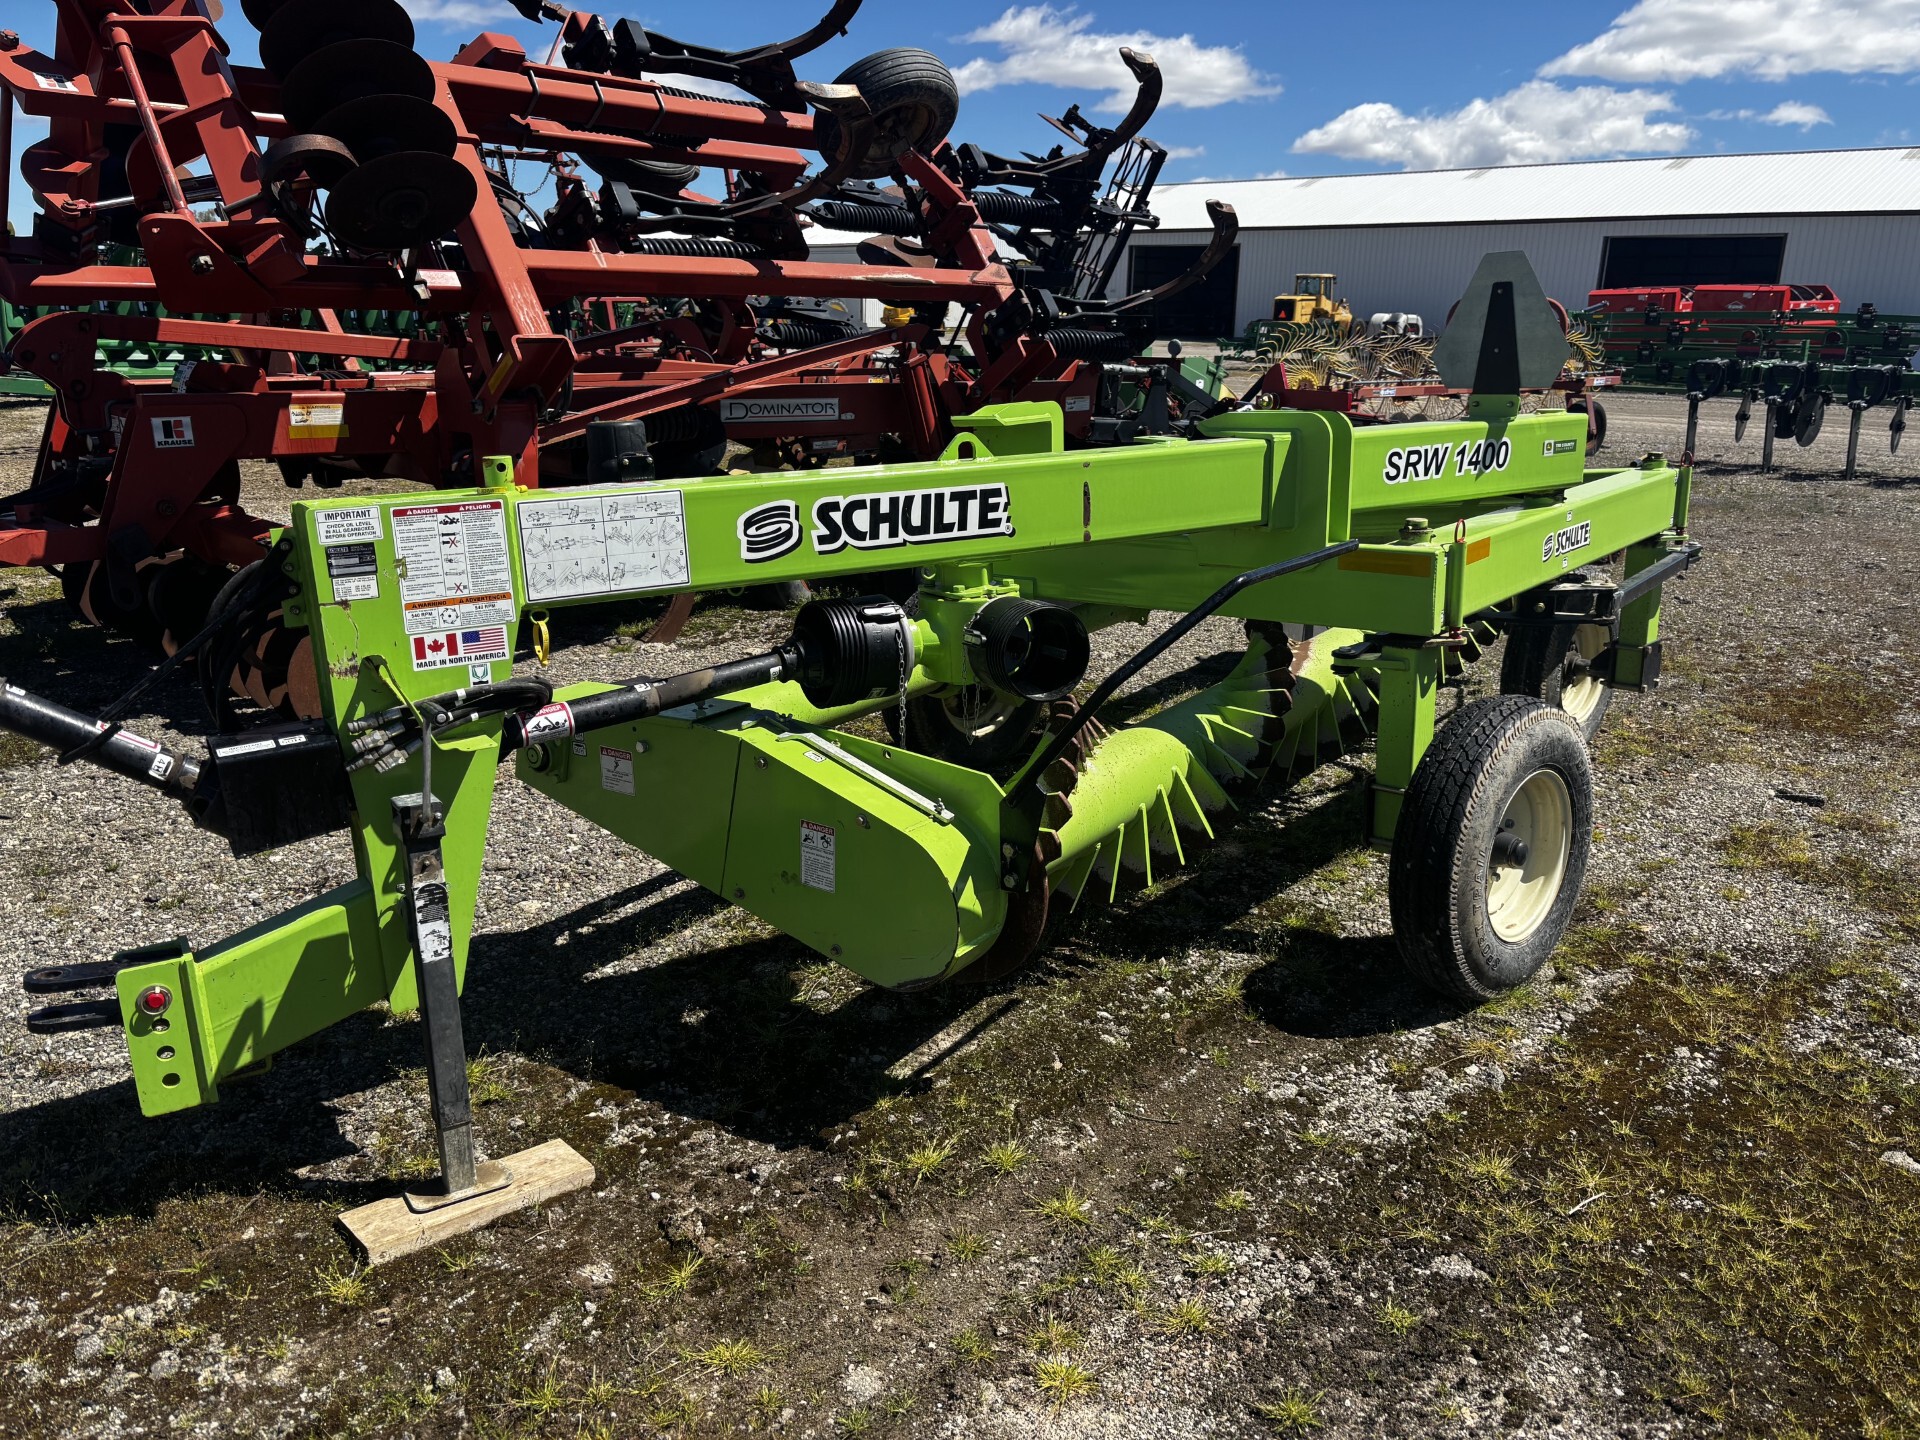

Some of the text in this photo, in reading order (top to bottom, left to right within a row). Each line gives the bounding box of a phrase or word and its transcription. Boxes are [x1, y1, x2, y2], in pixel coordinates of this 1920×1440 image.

[725, 402, 836, 420] DOMINATOR
[1384, 440, 1510, 482] SRW 1400
[324, 509, 371, 521] IMPORTANT
[815, 486, 1006, 547] SCHULTE
[1555, 522, 1590, 553] SCHULTE
[465, 594, 506, 603] ADVERTENCIA
[448, 656, 472, 664] NORTH
[474, 652, 506, 662] AMERICA
[607, 750, 631, 760] DANGER
[808, 823, 833, 834] DANGER
[1474, 925, 1500, 971] SPORT
